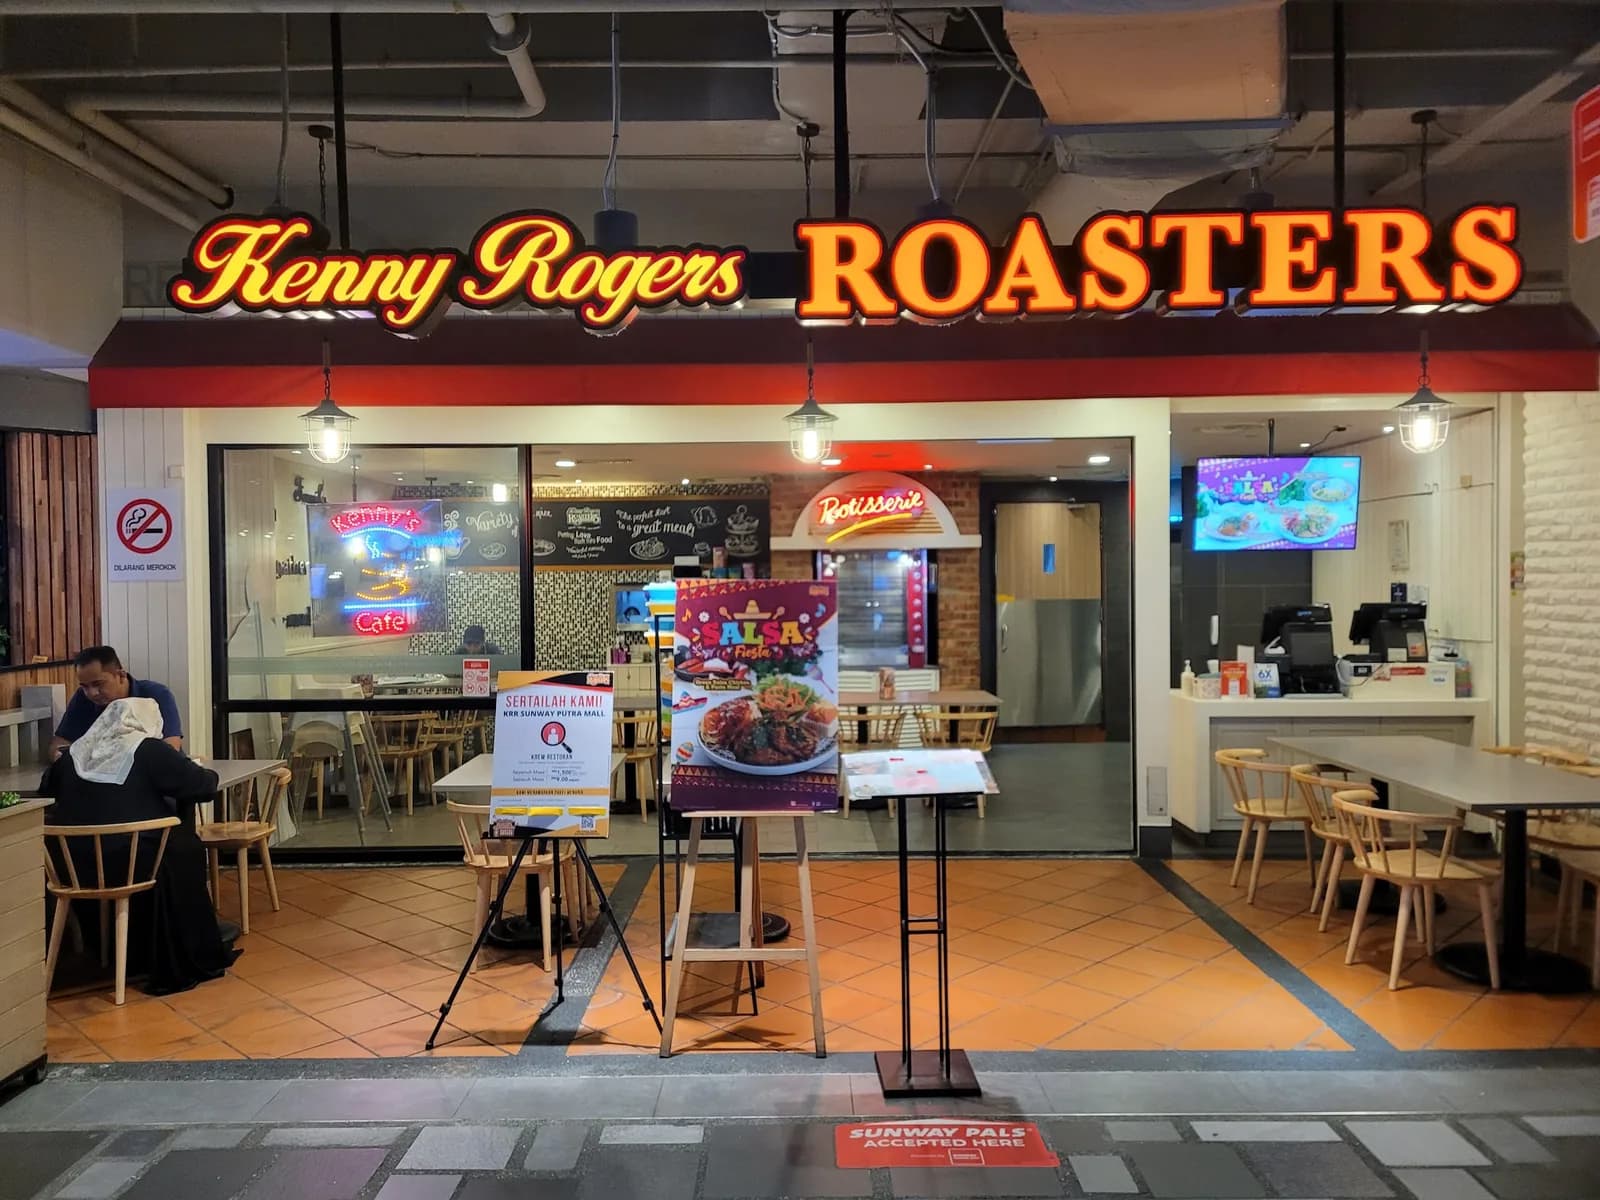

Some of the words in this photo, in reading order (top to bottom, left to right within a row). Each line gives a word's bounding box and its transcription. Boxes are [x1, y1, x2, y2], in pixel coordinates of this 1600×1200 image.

[175, 217, 452, 324] Kenny
[459, 215, 745, 323] Rogers
[797, 205, 1521, 318] ROASTERS
[818, 489, 924, 525] Rotisserie
[331, 505, 421, 534] Kenny's
[631, 519, 662, 538] great
[113, 564, 145, 572] DILARANG
[146, 564, 177, 572] MEROKOK
[355, 610, 407, 635] Cafe
[701, 620, 805, 647] SALSA
[734, 644, 773, 661] Fiesta
[1257, 669, 1272, 680] 6X
[505, 695, 567, 708] SERTAILAH
[570, 695, 603, 708] KAMI!
[503, 710, 519, 718] KRR
[520, 710, 556, 718] SUNWAY
[557, 710, 582, 718] PUTRA
[584, 710, 606, 718] MALL
[849, 1127, 959, 1139] SUNWAY
[965, 1127, 1026, 1138] PALS
[863, 1138, 970, 1148] ACCEPTED
[972, 1138, 1025, 1148] HERE
